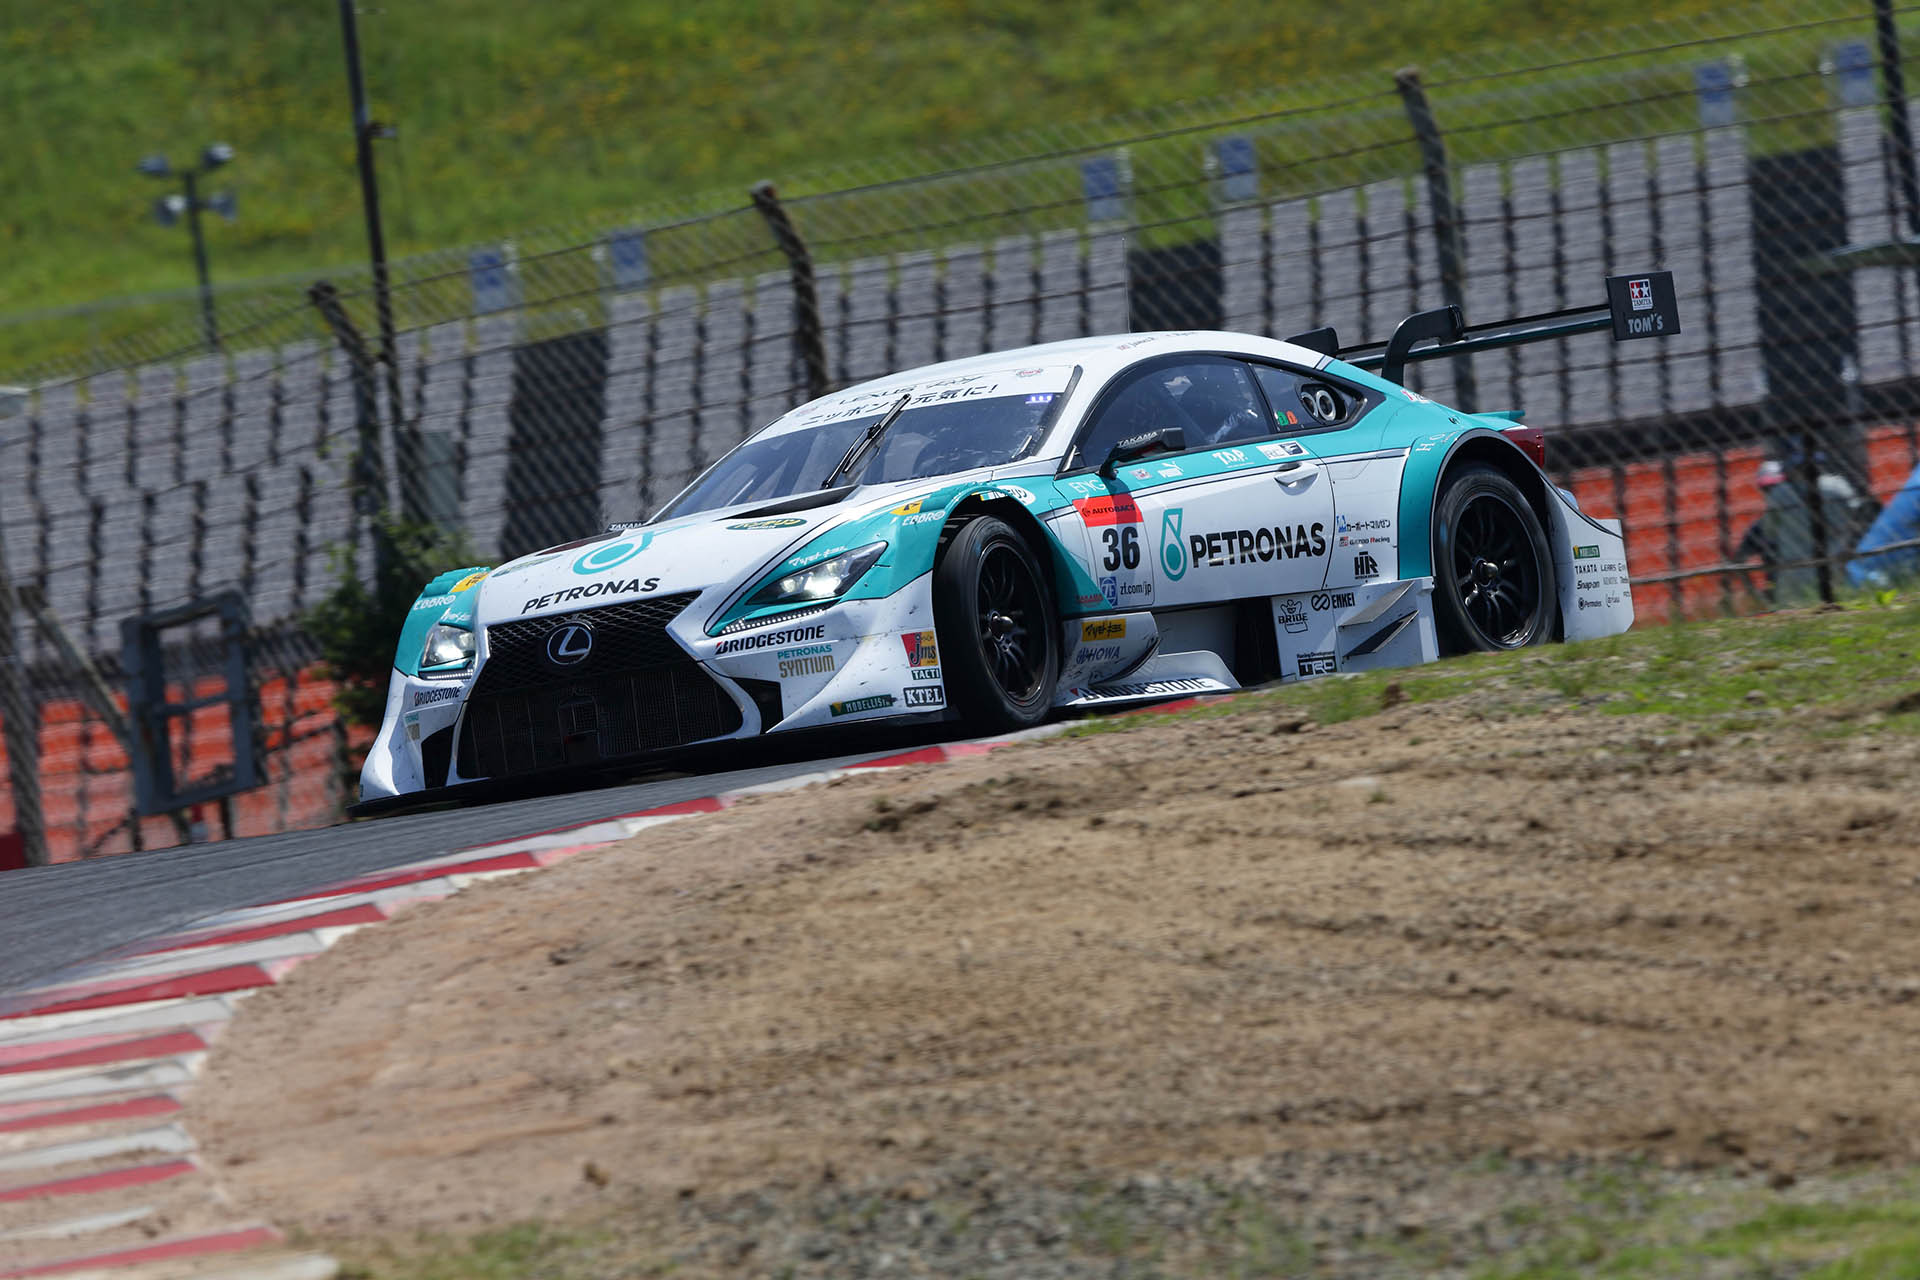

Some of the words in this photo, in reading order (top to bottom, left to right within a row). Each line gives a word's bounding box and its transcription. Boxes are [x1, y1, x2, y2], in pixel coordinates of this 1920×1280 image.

[1627, 313, 1664, 334] TOM'S
[802, 384, 999, 427] ニッポン元気に!
[1091, 503, 1136, 515] AUTOBACS
[902, 511, 946, 527] EBBRO
[1102, 527, 1141, 573] 36
[1189, 522, 1325, 569] PETRONAS
[1575, 563, 1598, 575] TAKATA
[520, 576, 661, 615] PETRONAS
[1120, 581, 1152, 597] zf.com/jp
[413, 595, 457, 611] EBBRO
[1331, 592, 1356, 609] ENKEI
[1278, 612, 1308, 625] BRIDE
[715, 624, 826, 655] BRIDGESTONE
[777, 644, 833, 660] PETRONAS
[1089, 645, 1121, 662] HOWA
[778, 654, 836, 679] SYNTIUM
[913, 669, 940, 680] TACTI
[1300, 659, 1336, 676] TRD
[414, 685, 463, 707] BRIDGESTONE
[905, 688, 943, 704] KTEL
[1070, 676, 1213, 701] BRIDGESTONE
